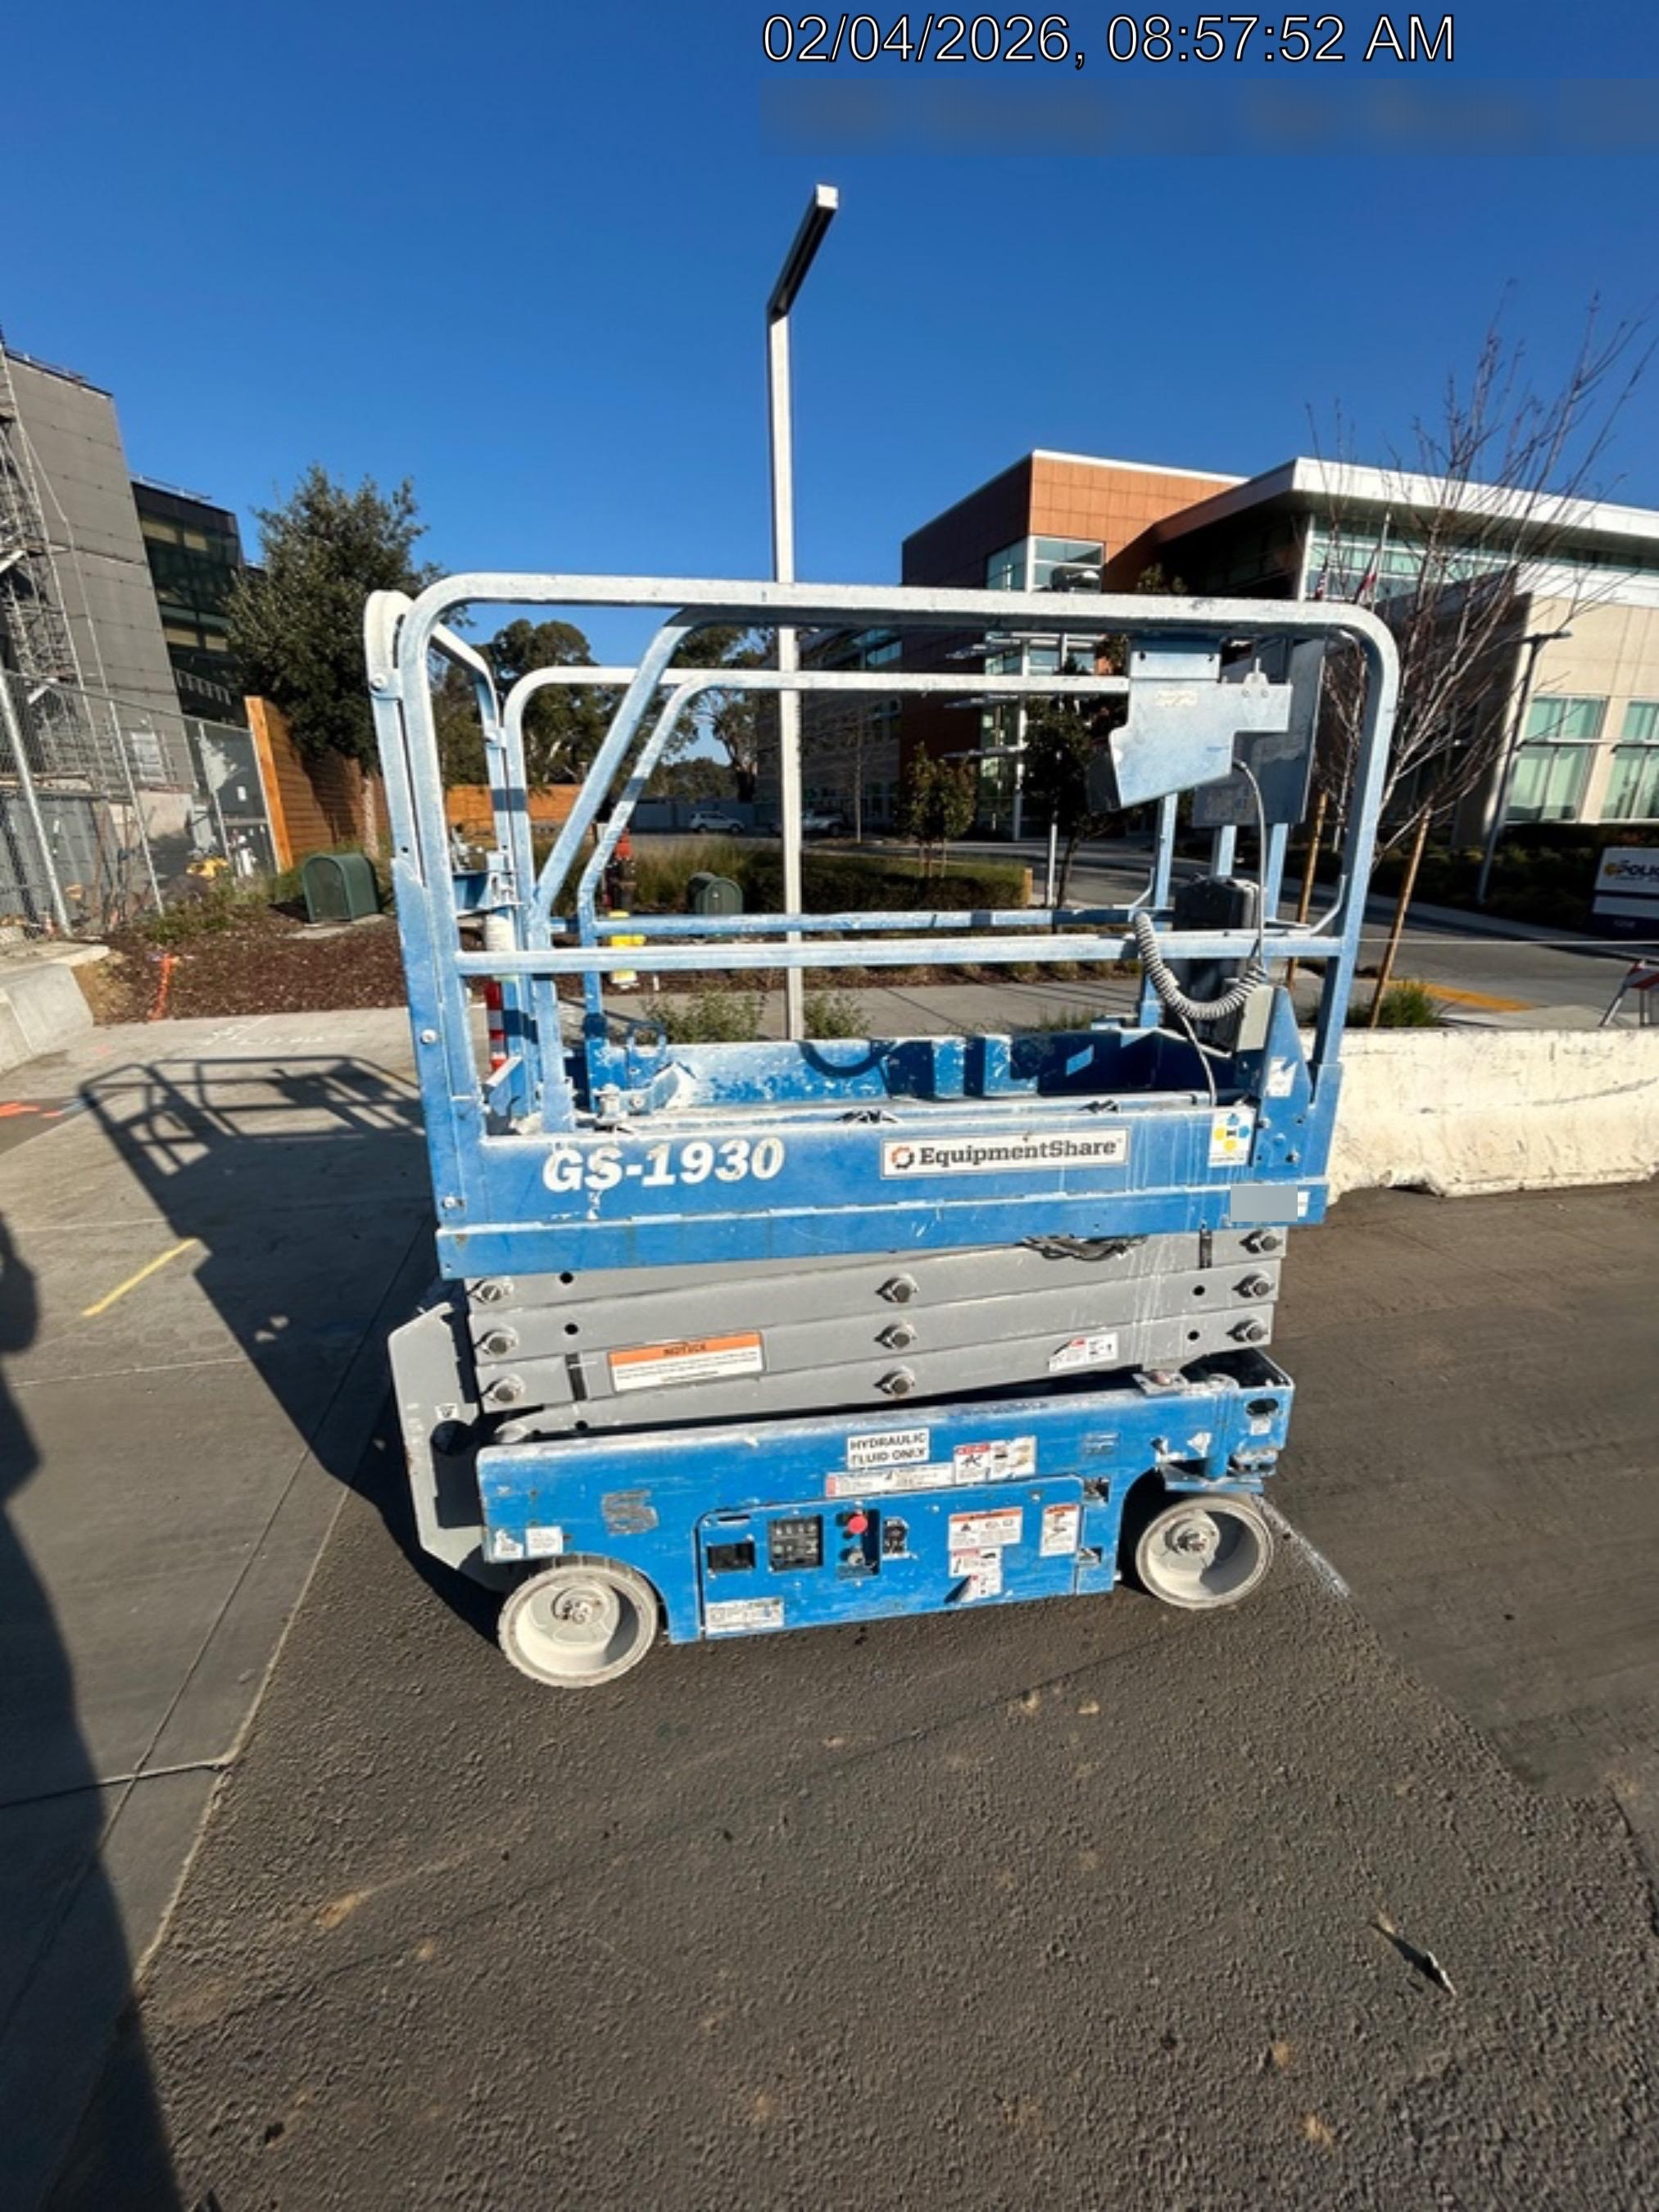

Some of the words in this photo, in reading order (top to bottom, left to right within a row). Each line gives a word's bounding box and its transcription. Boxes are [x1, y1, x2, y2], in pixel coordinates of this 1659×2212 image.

[542, 1136, 785, 1193] GS-1930
[918, 1138, 1117, 1168] EquipmentShare
[850, 1432, 926, 1450] HYDRAULIC
